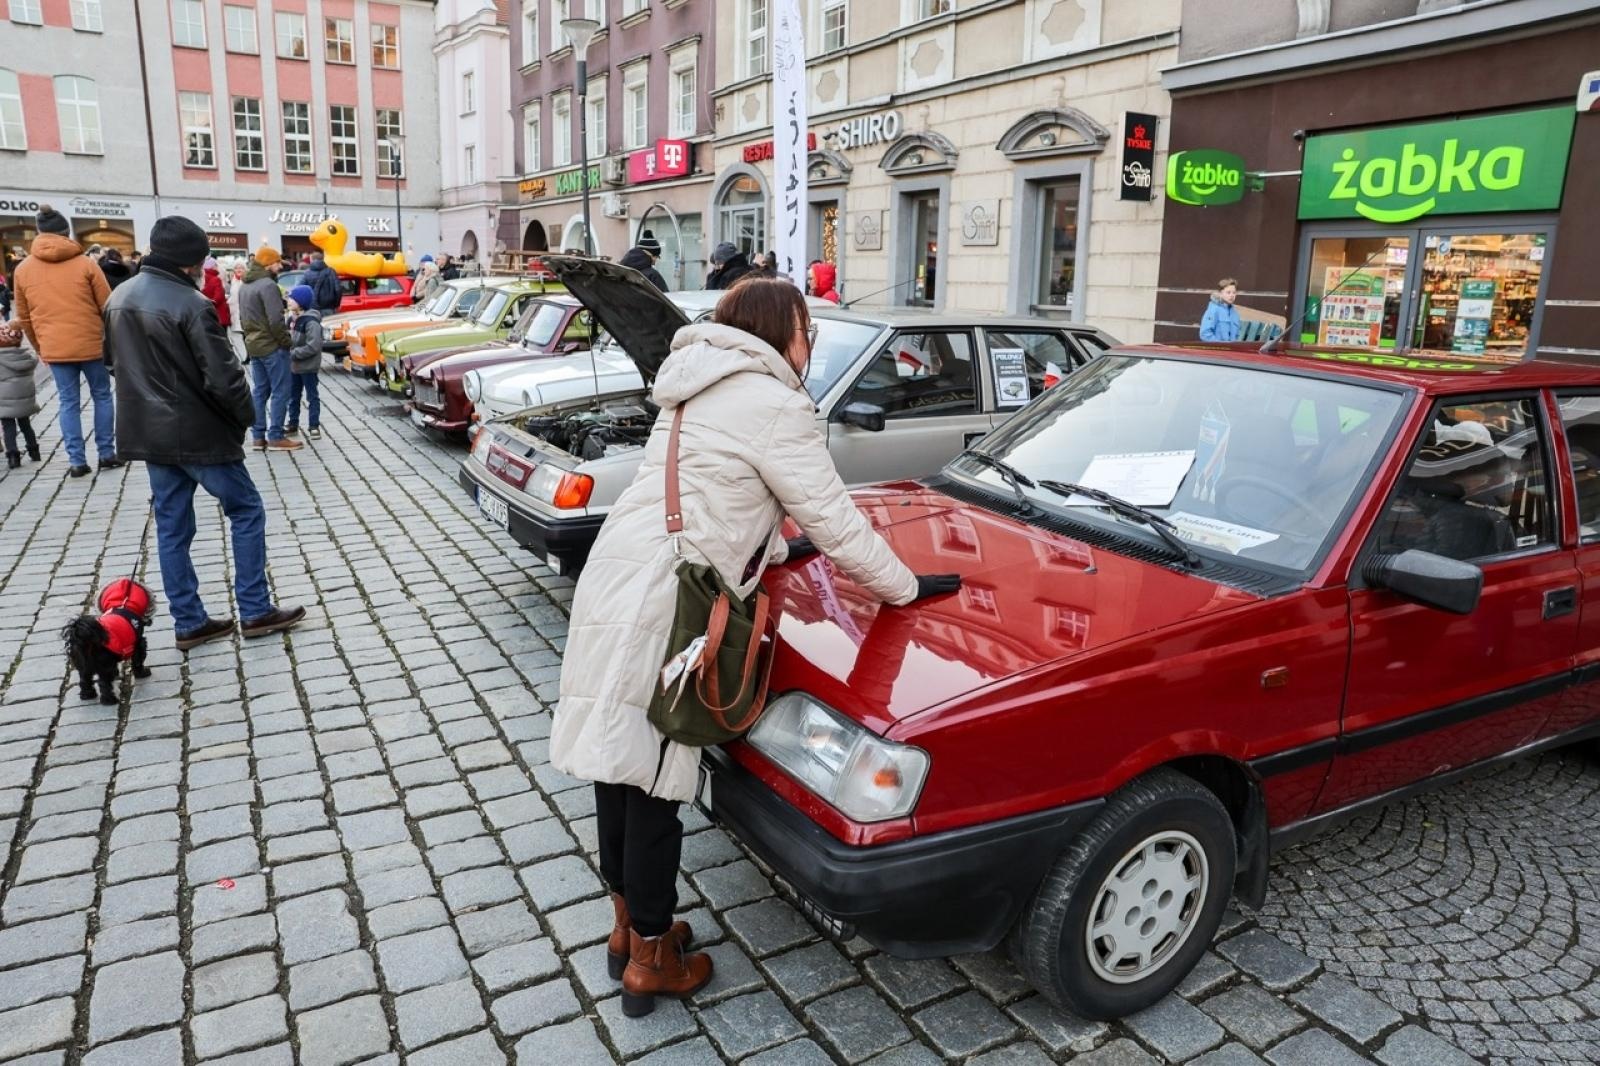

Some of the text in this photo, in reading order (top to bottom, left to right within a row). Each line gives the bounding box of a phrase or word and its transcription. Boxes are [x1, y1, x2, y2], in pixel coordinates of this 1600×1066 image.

[838, 110, 903, 151] SHIRO
[1126, 138, 1152, 150] TYSKIE
[1182, 160, 1240, 186] żabka
[1328, 138, 1525, 199] żabka
[75, 207, 126, 216] RACIBORSKA
